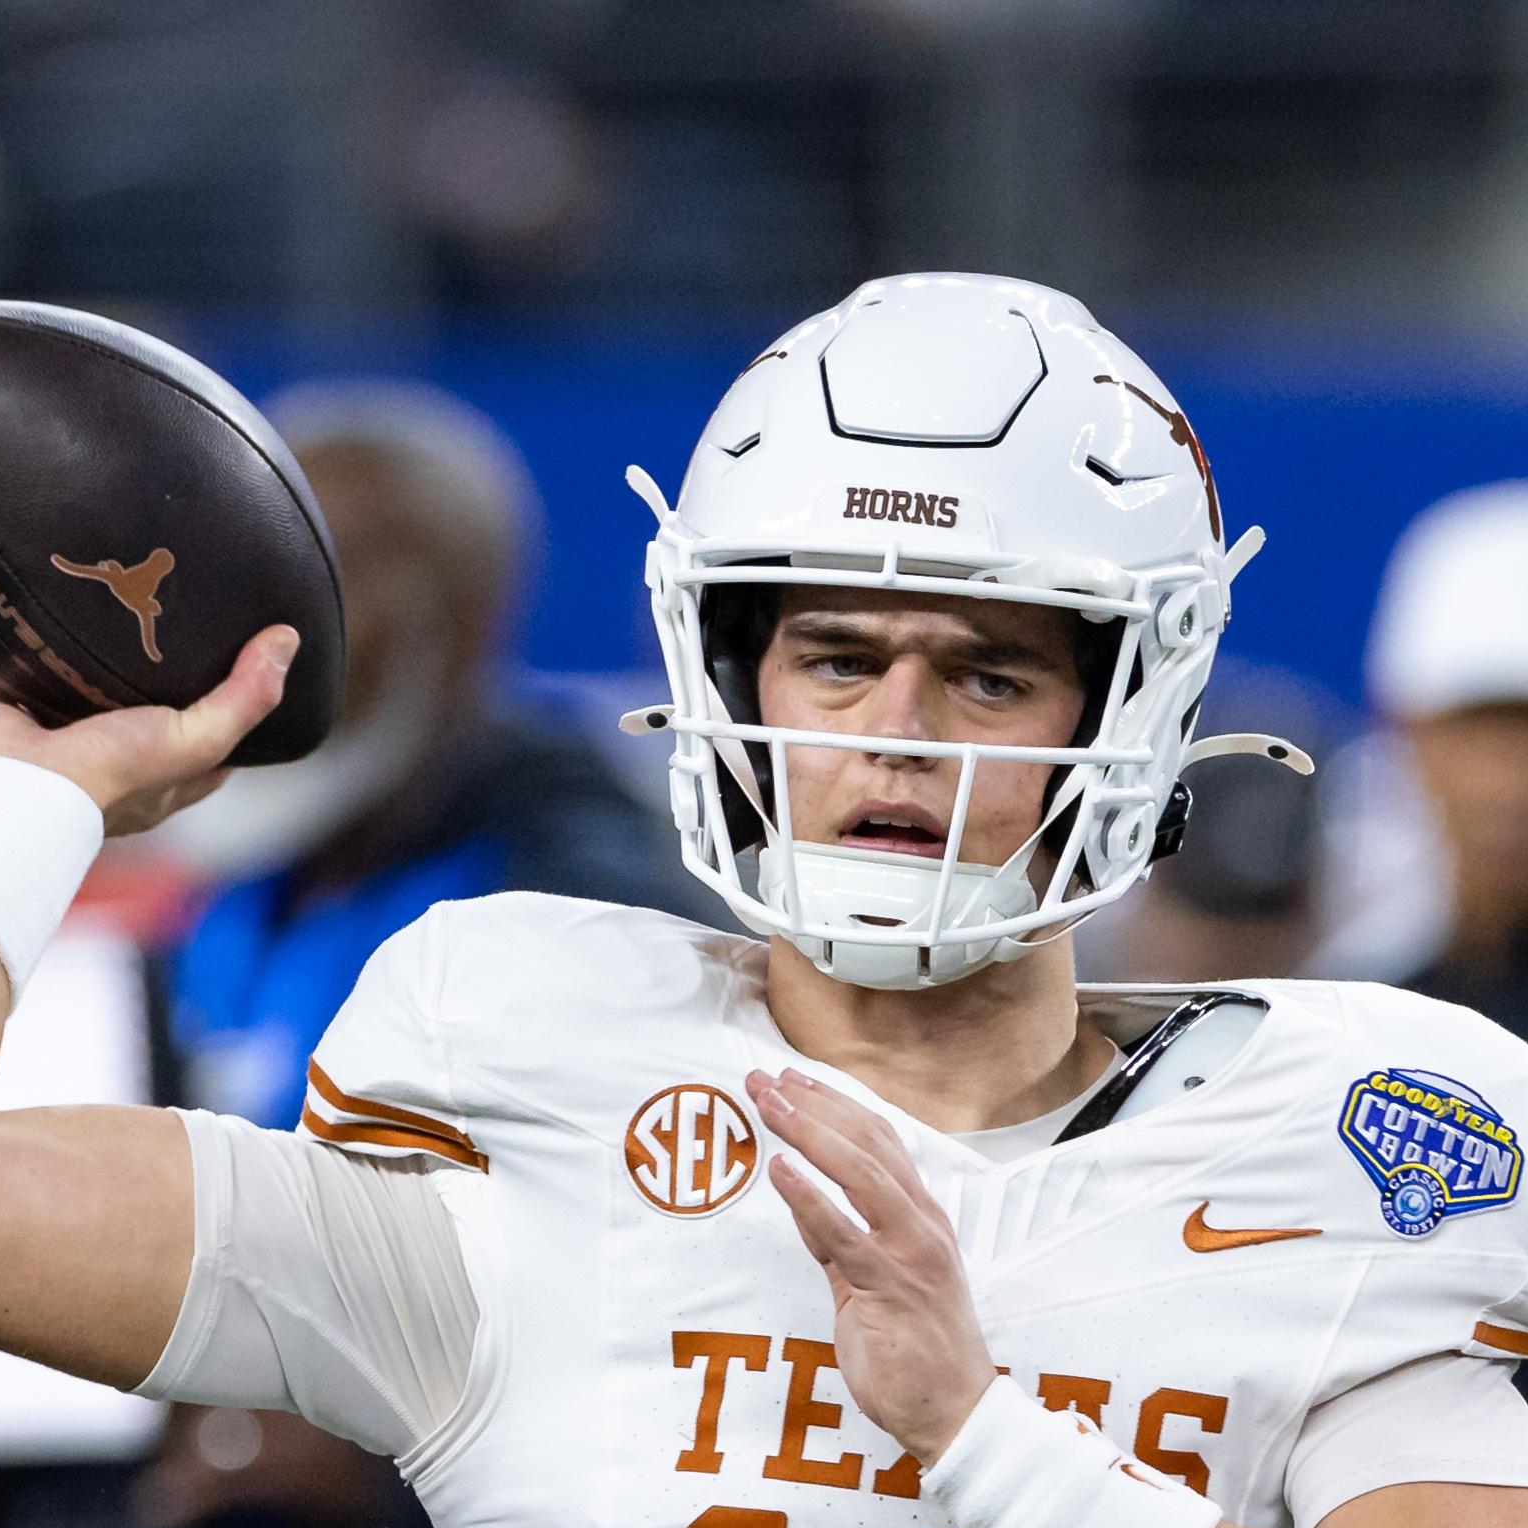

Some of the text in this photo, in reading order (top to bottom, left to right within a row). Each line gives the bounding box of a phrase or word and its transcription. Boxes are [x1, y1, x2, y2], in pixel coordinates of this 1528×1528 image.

[843, 487, 959, 529] HORNS
[633, 1090, 749, 1207] SEC
[1354, 1093, 1514, 1190] COTTON
[1377, 1133, 1478, 1191] BOWL
[1388, 1169, 1445, 1209] CLASSIC
[672, 1331, 1229, 1499] TES
